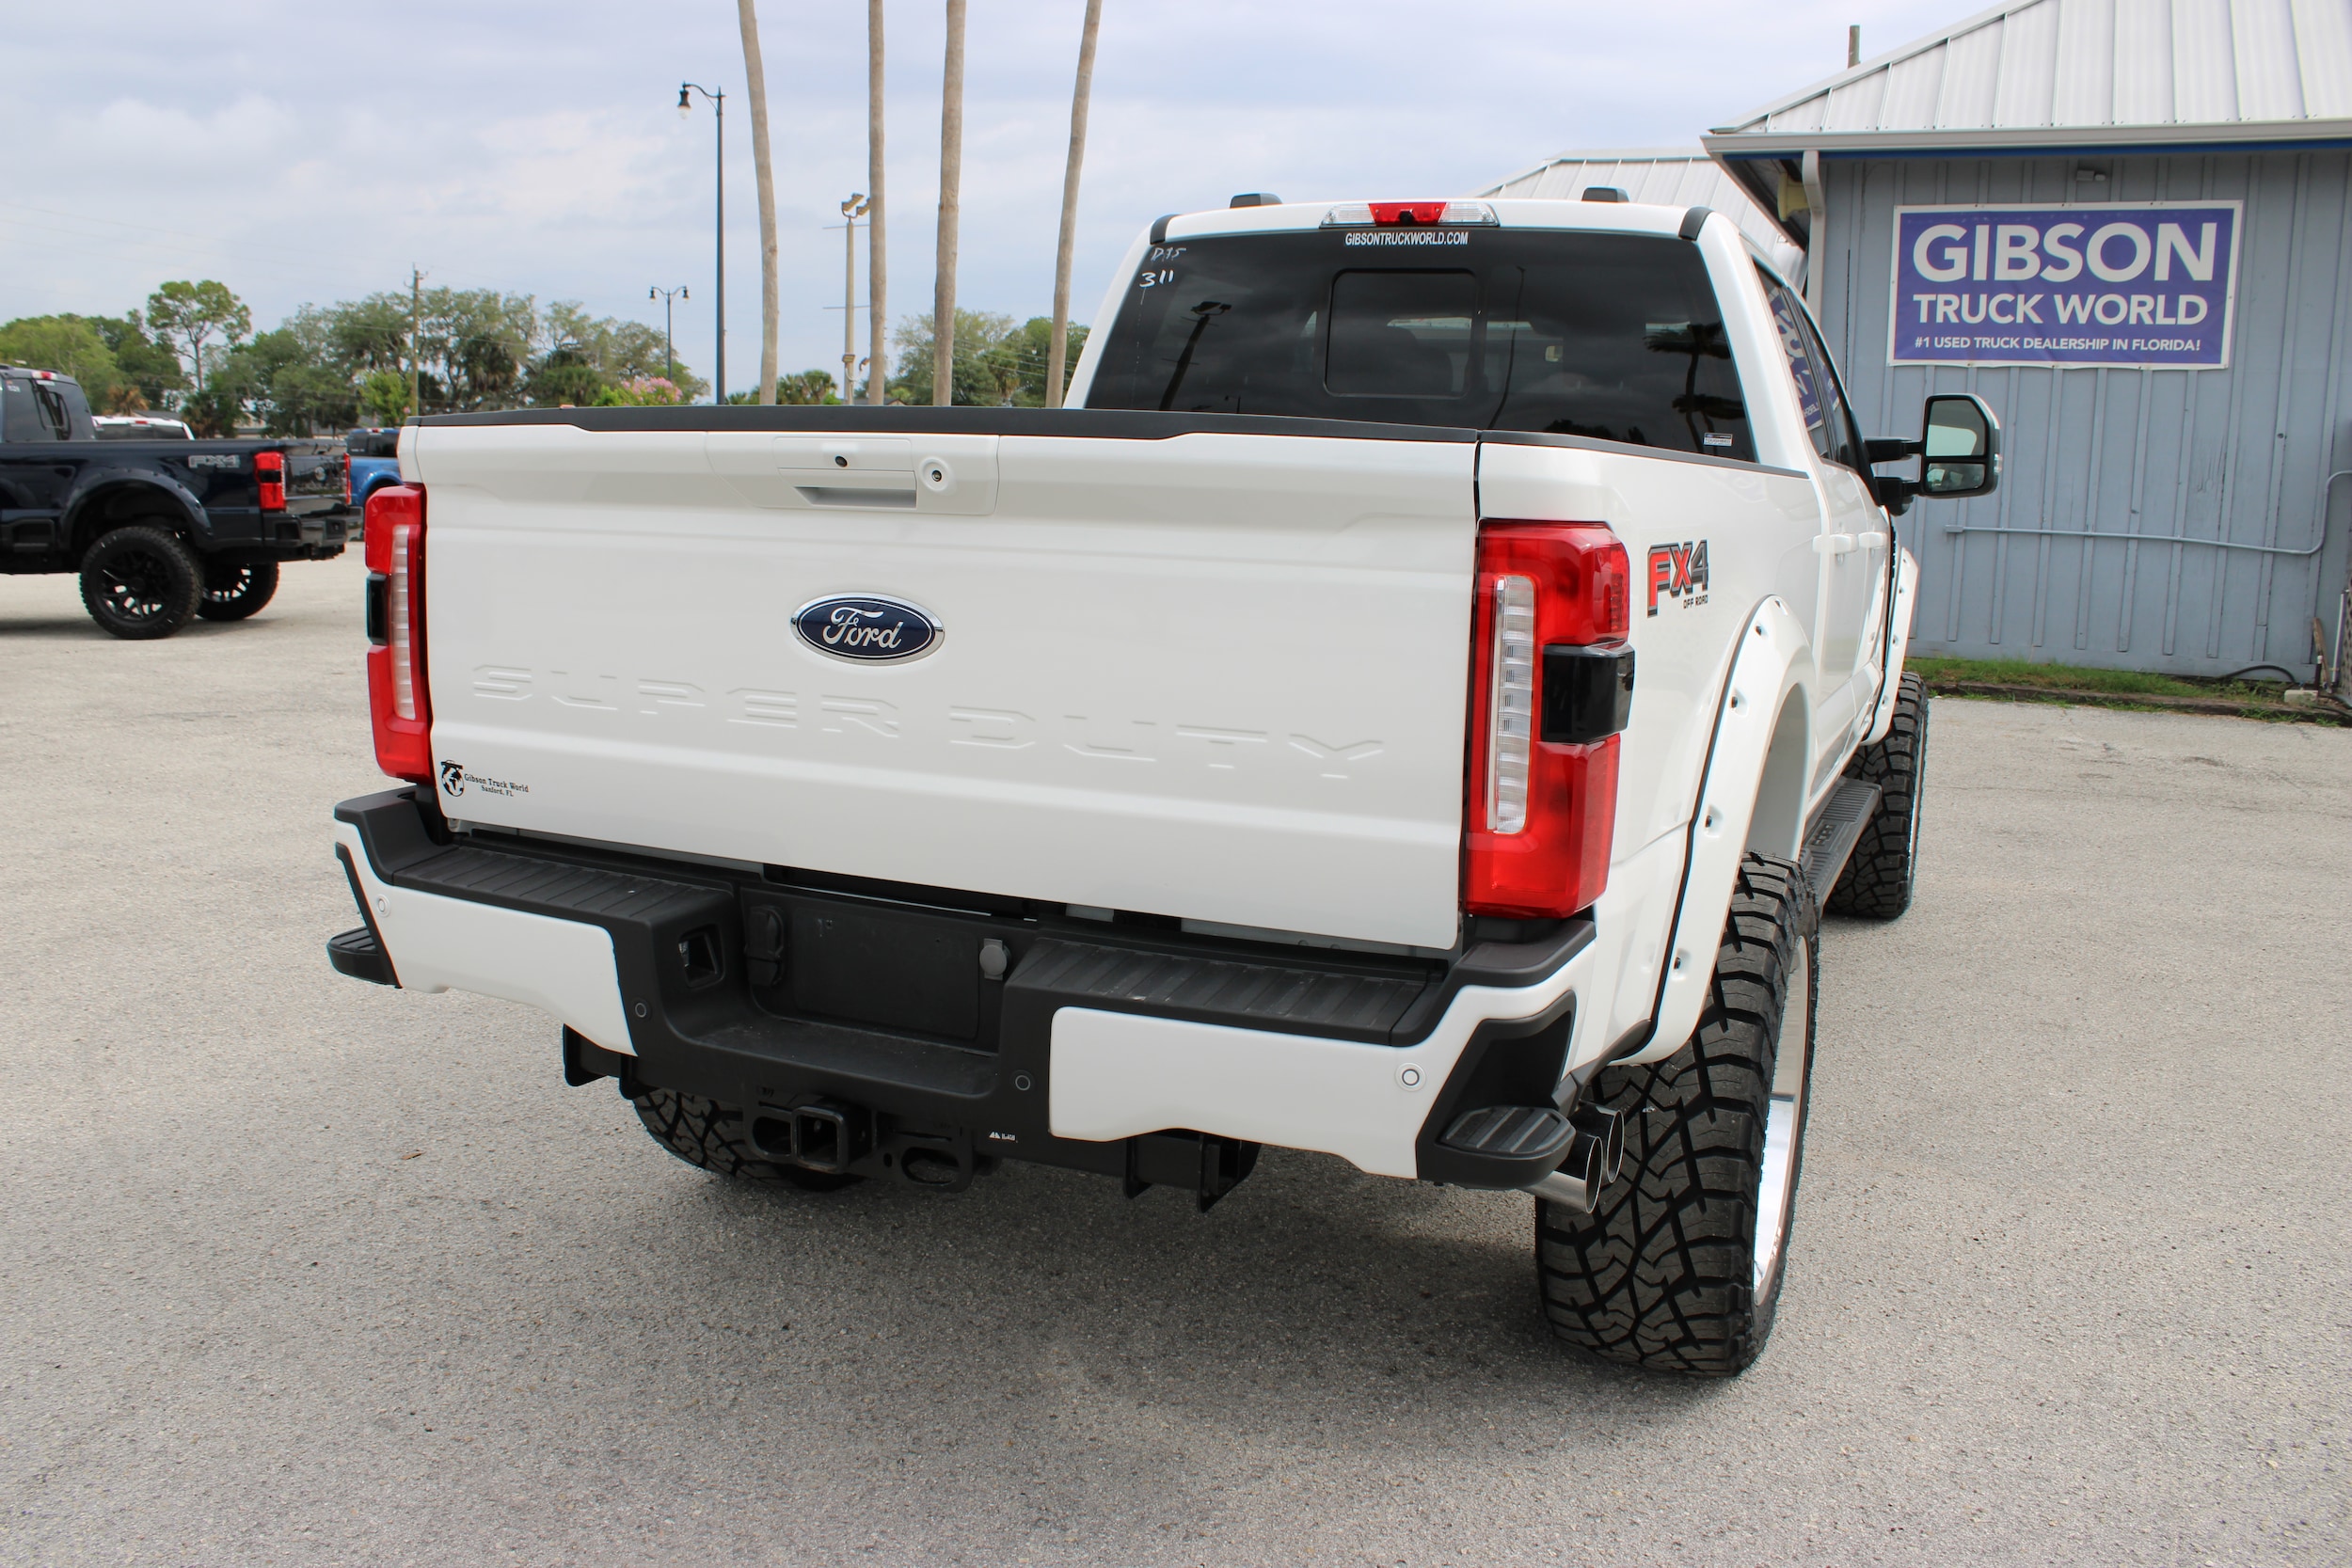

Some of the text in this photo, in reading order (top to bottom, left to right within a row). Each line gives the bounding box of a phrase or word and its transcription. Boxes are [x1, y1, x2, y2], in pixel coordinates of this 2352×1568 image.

[1344, 231, 1469, 245] GIBSONTRUCKWORLD.COM
[1913, 221, 2217, 283] GIBSON
[1139, 269, 1174, 288] 311
[1913, 293, 2208, 325] TRUCK WORLD
[1915, 337, 2201, 352] #1 USED TRUCK DEALERSHIP IN FLORIDA!
[1646, 539, 1709, 618] FX4
[1683, 594, 1708, 610] OFF ROAD
[822, 607, 904, 649] Ford
[473, 664, 1384, 779] SUPER DUTY
[464, 773, 530, 792] Gibson Truck World
